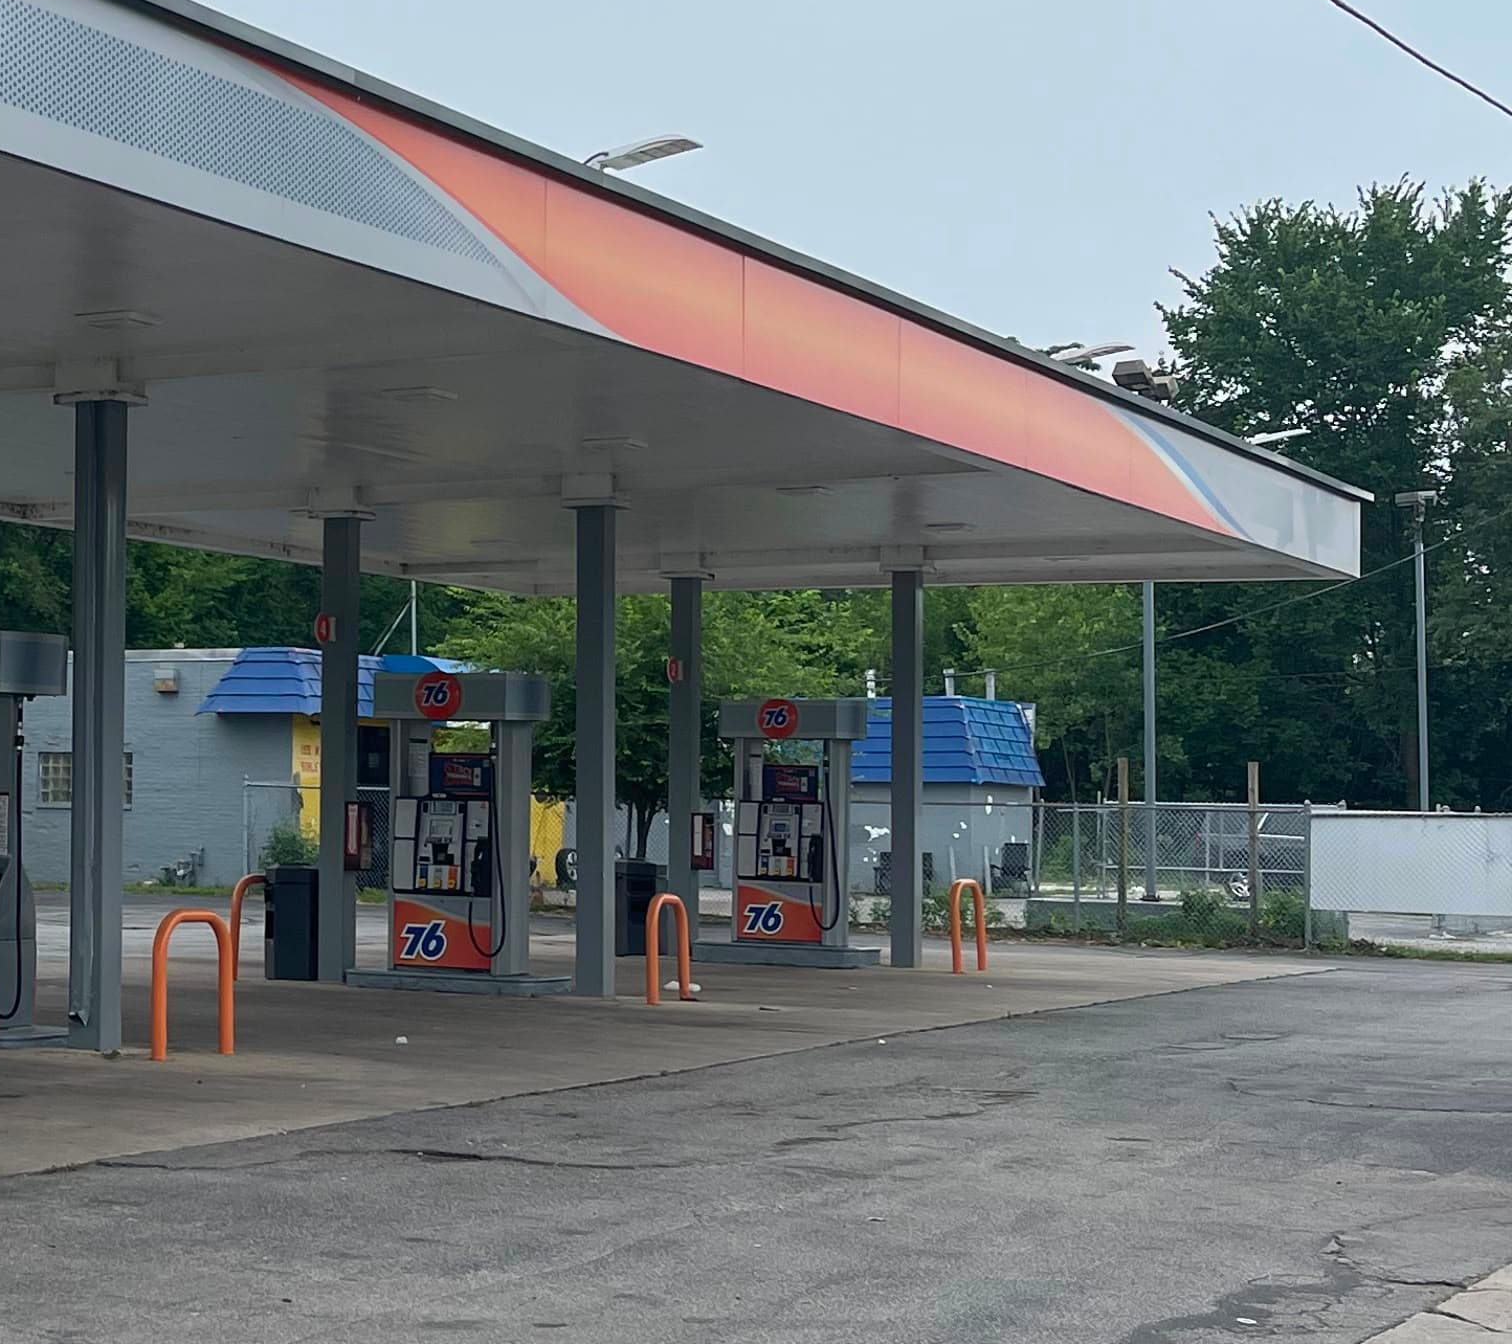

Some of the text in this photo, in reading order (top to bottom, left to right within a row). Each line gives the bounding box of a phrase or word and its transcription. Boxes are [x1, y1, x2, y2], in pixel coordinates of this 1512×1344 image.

[421, 680, 450, 707] 76
[762, 705, 789, 729] 76
[743, 901, 784, 935] 76
[400, 919, 448, 961] 76
